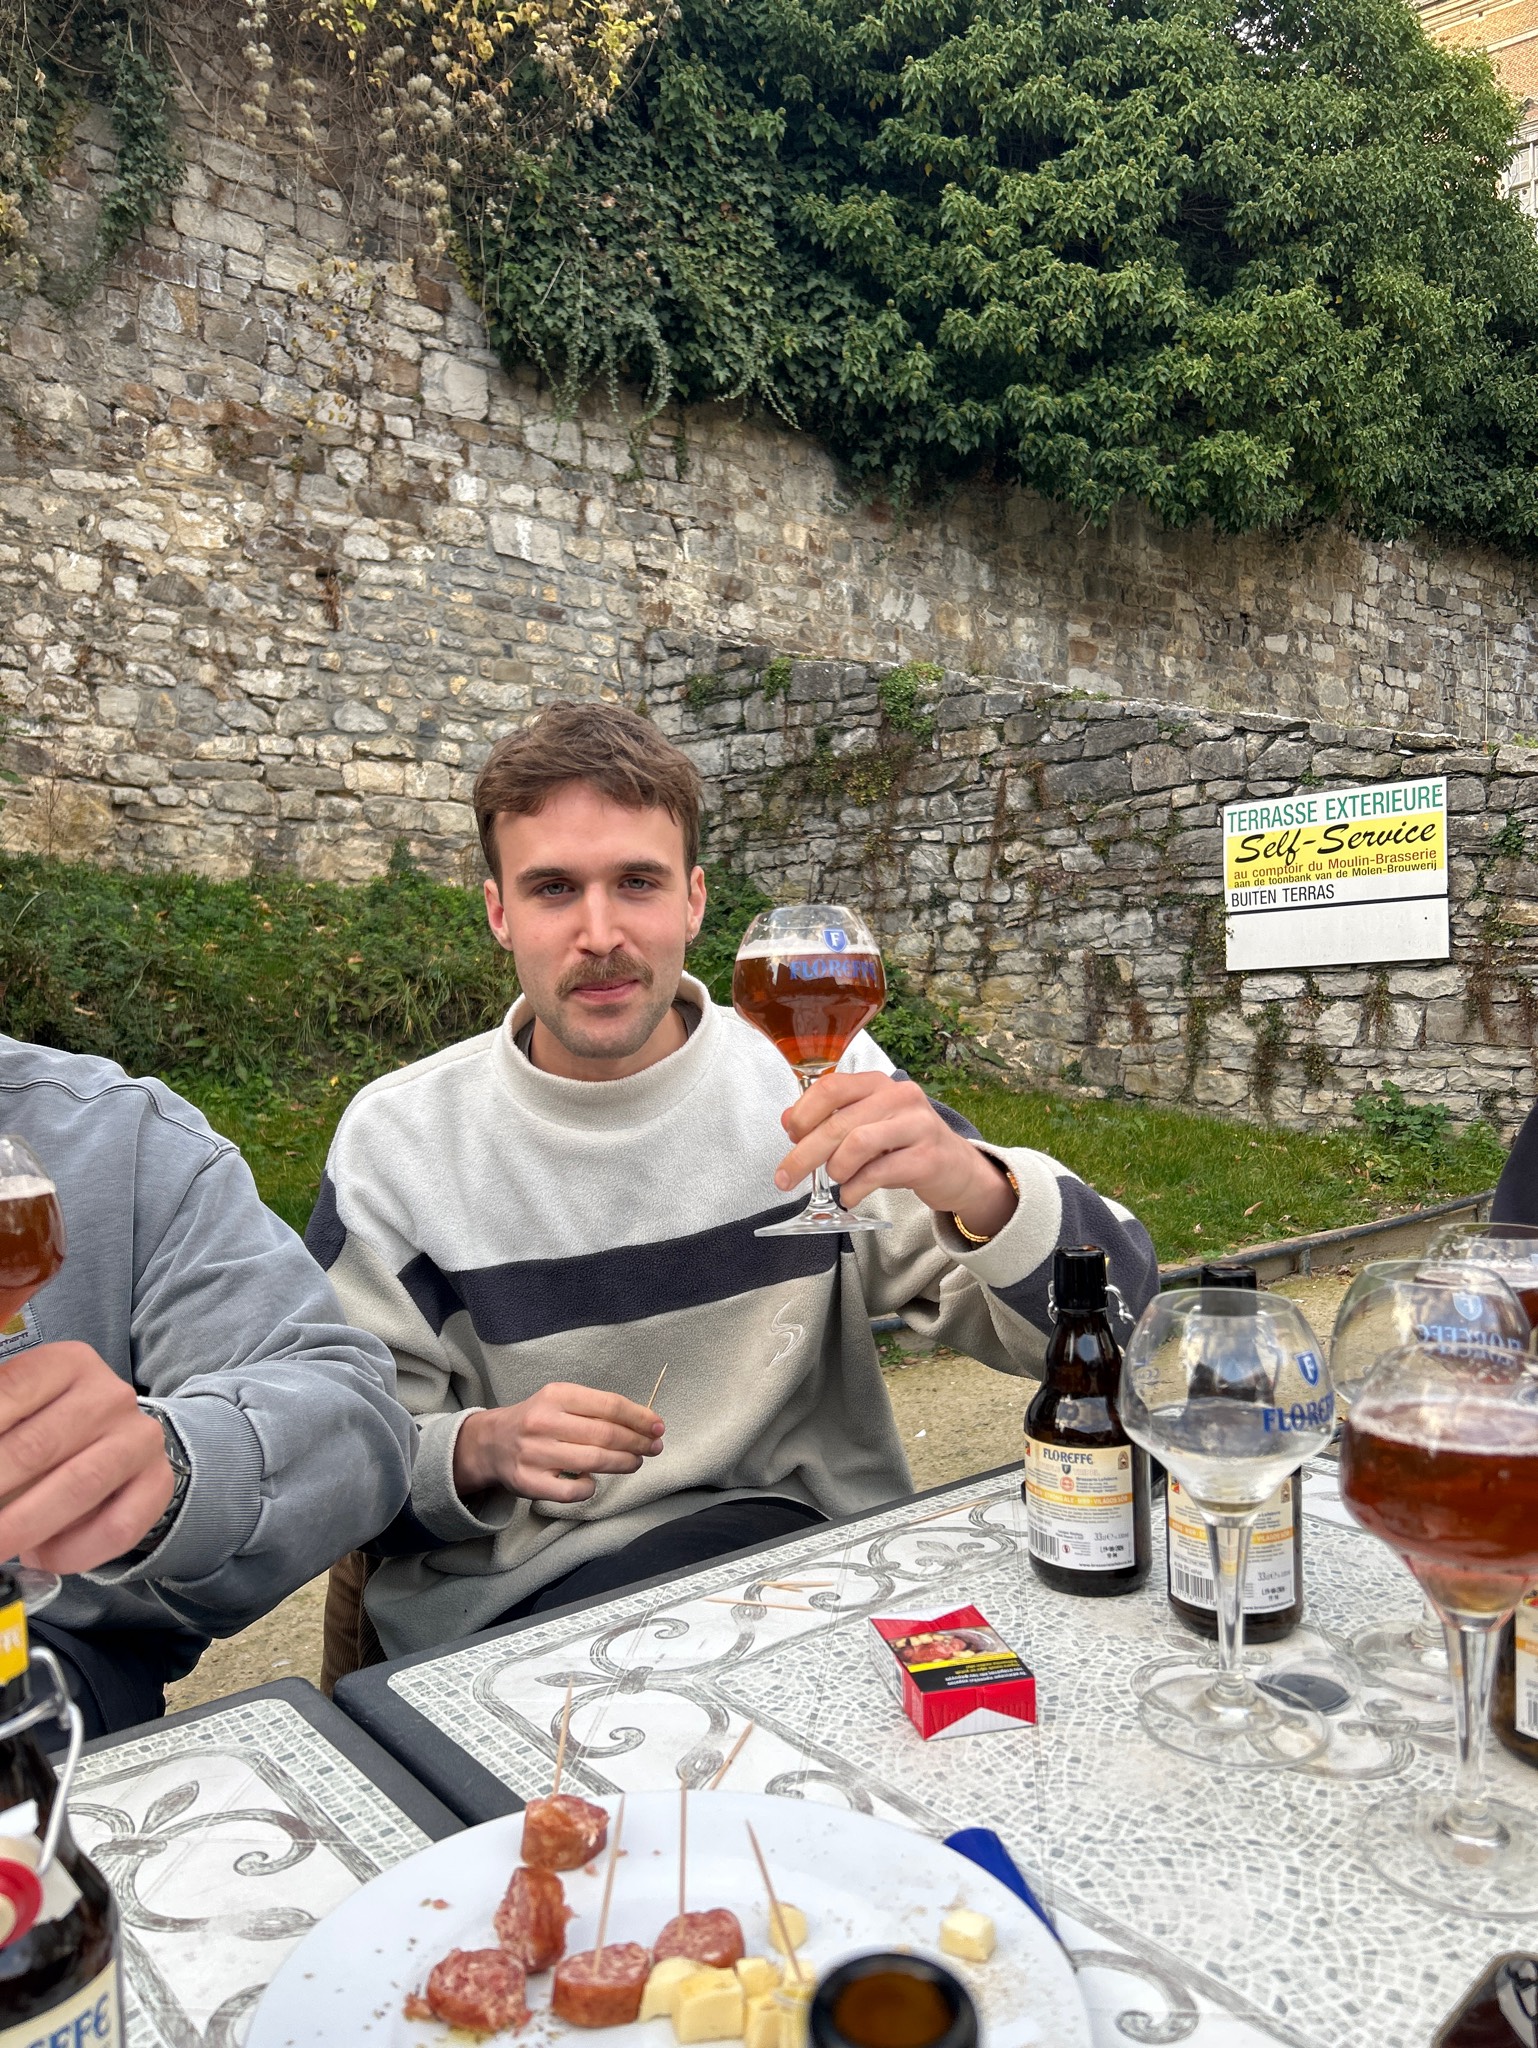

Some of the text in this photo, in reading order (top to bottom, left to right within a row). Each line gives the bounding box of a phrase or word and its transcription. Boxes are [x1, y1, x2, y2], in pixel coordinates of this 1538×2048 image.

[1227, 784, 1443, 833] TERRASSE EXTERIEURE
[1234, 821, 1437, 866] Self-Service
[1234, 848, 1437, 880] au comptoir du Moulin-Brasserie
[1234, 860, 1438, 889] aan de toonbank van de Molen-Brouwerij
[1231, 884, 1335, 908] BUITEN TERRAS
[1042, 1447, 1094, 1465] FLOREFFE
